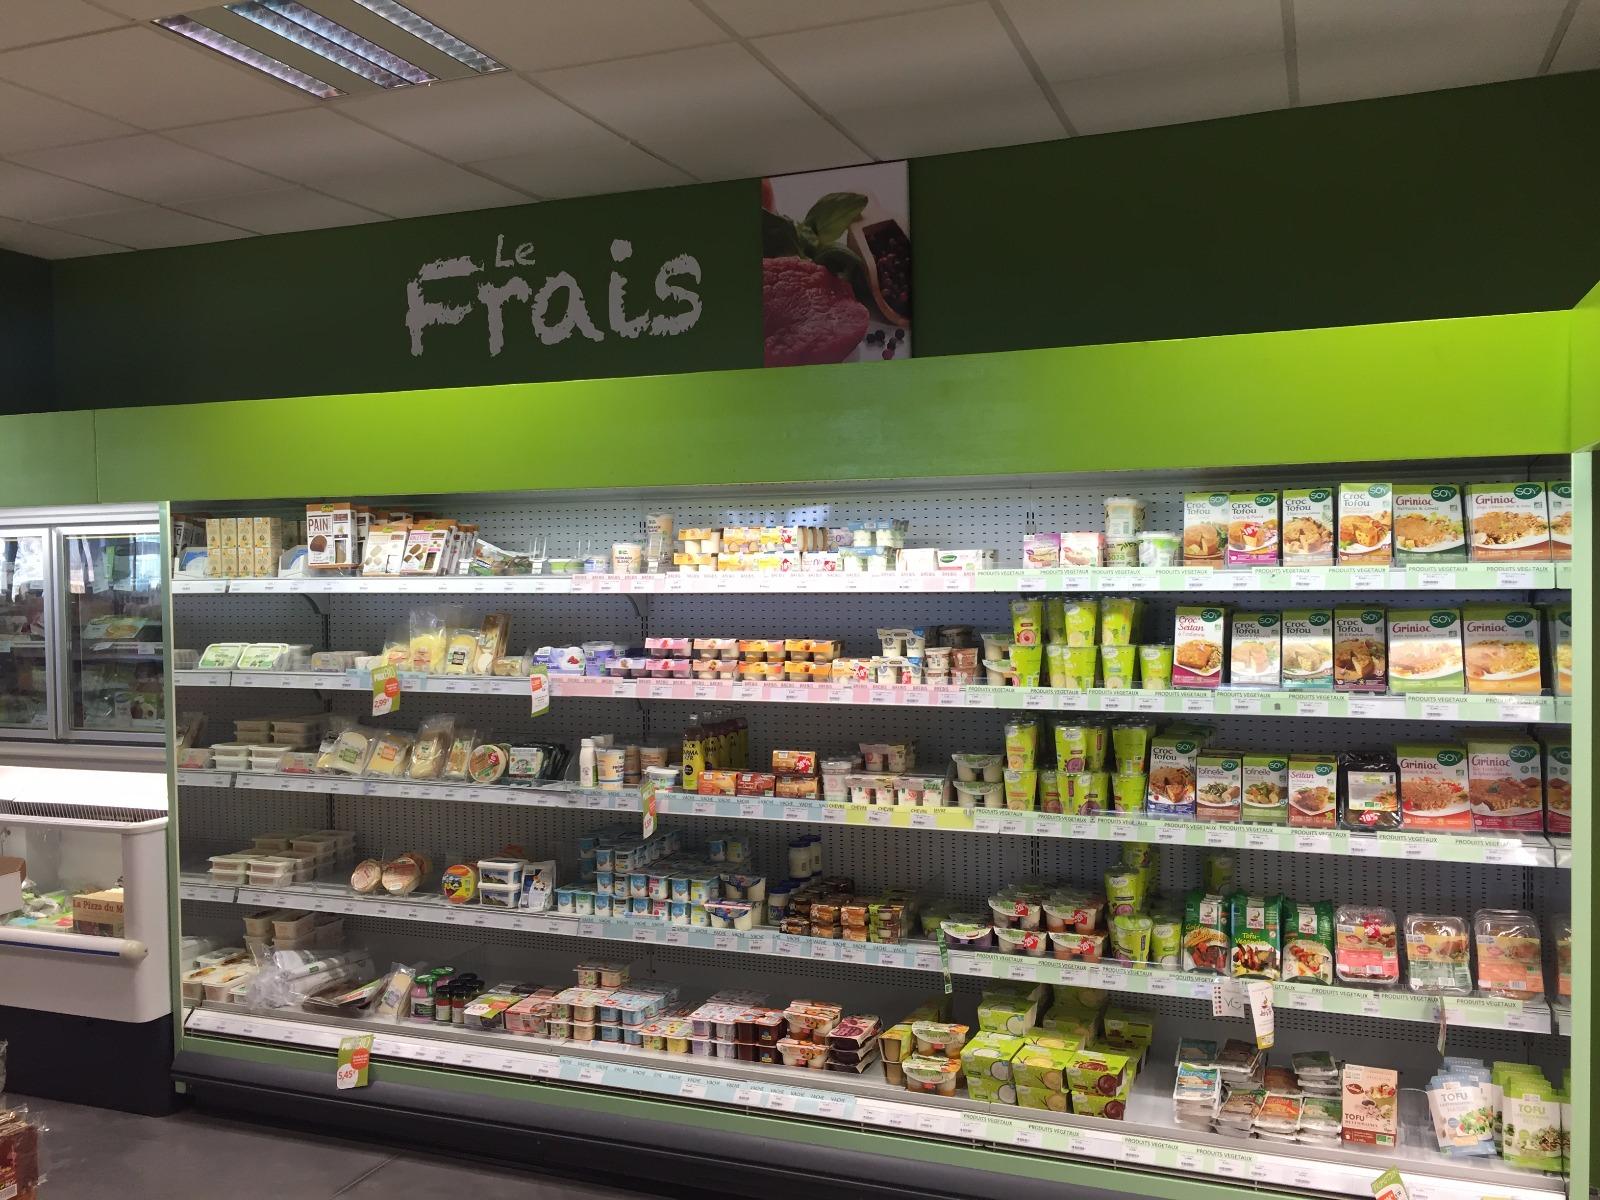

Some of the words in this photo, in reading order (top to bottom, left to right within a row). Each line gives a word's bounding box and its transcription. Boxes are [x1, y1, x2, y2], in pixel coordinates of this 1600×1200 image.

[496, 233, 536, 267] Le
[405, 238, 702, 357] Frais
[1432, 489, 1452, 498] SOY
[1515, 487, 1539, 496] SOY
[308, 518, 329, 532] PAIN
[1431, 615, 1451, 624] SOY
[1507, 615, 1528, 623] SOY
[1439, 753, 1461, 762] SOY
[1511, 749, 1535, 759] SOY
[73, 900, 81, 908] La
[104, 903, 114, 912] du
[1441, 1092, 1468, 1102] TOFU
[1518, 1103, 1546, 1114] TOFU
[1344, 1112, 1365, 1123] TOFU
